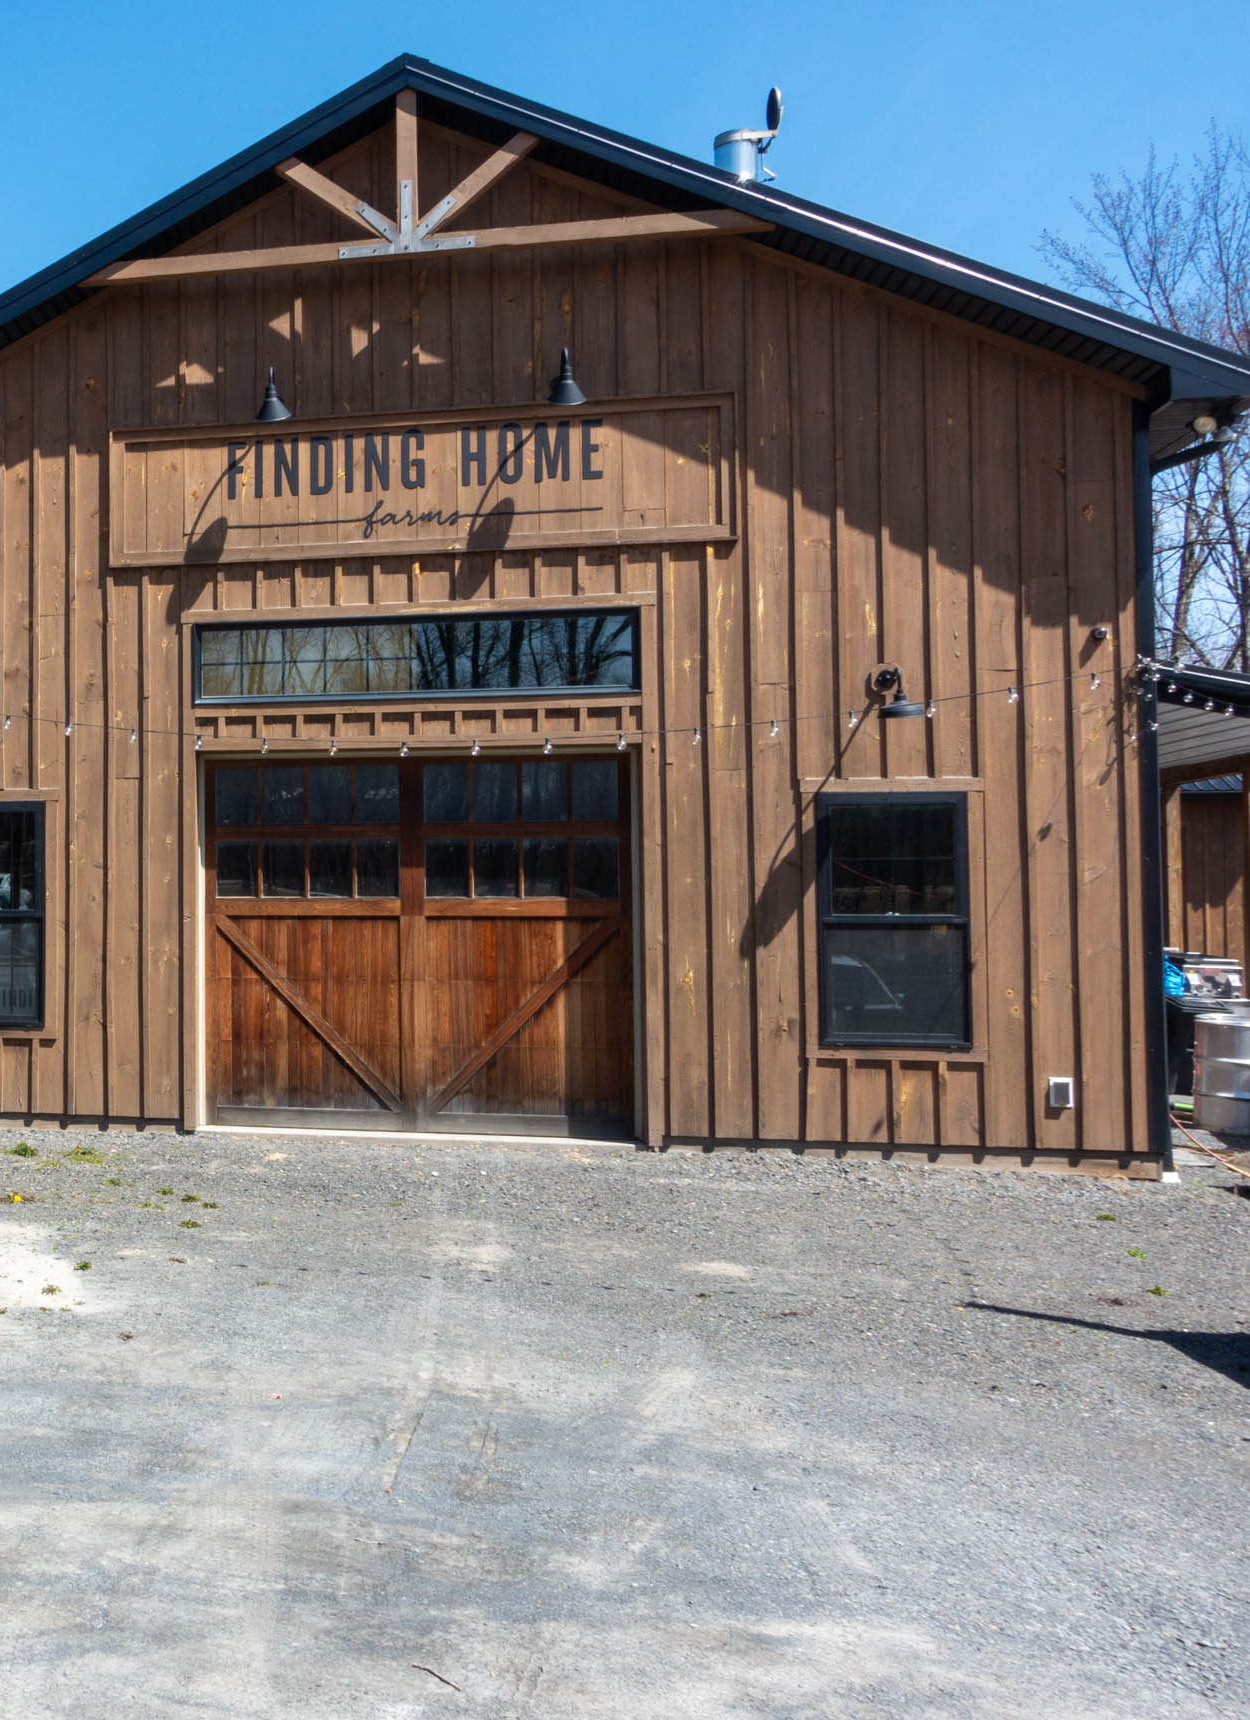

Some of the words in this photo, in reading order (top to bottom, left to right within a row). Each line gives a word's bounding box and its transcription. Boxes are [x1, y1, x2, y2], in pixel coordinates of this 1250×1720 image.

[226, 427, 426, 499] FINDING
[461, 418, 604, 487] HOME
[364, 499, 459, 539] farms
